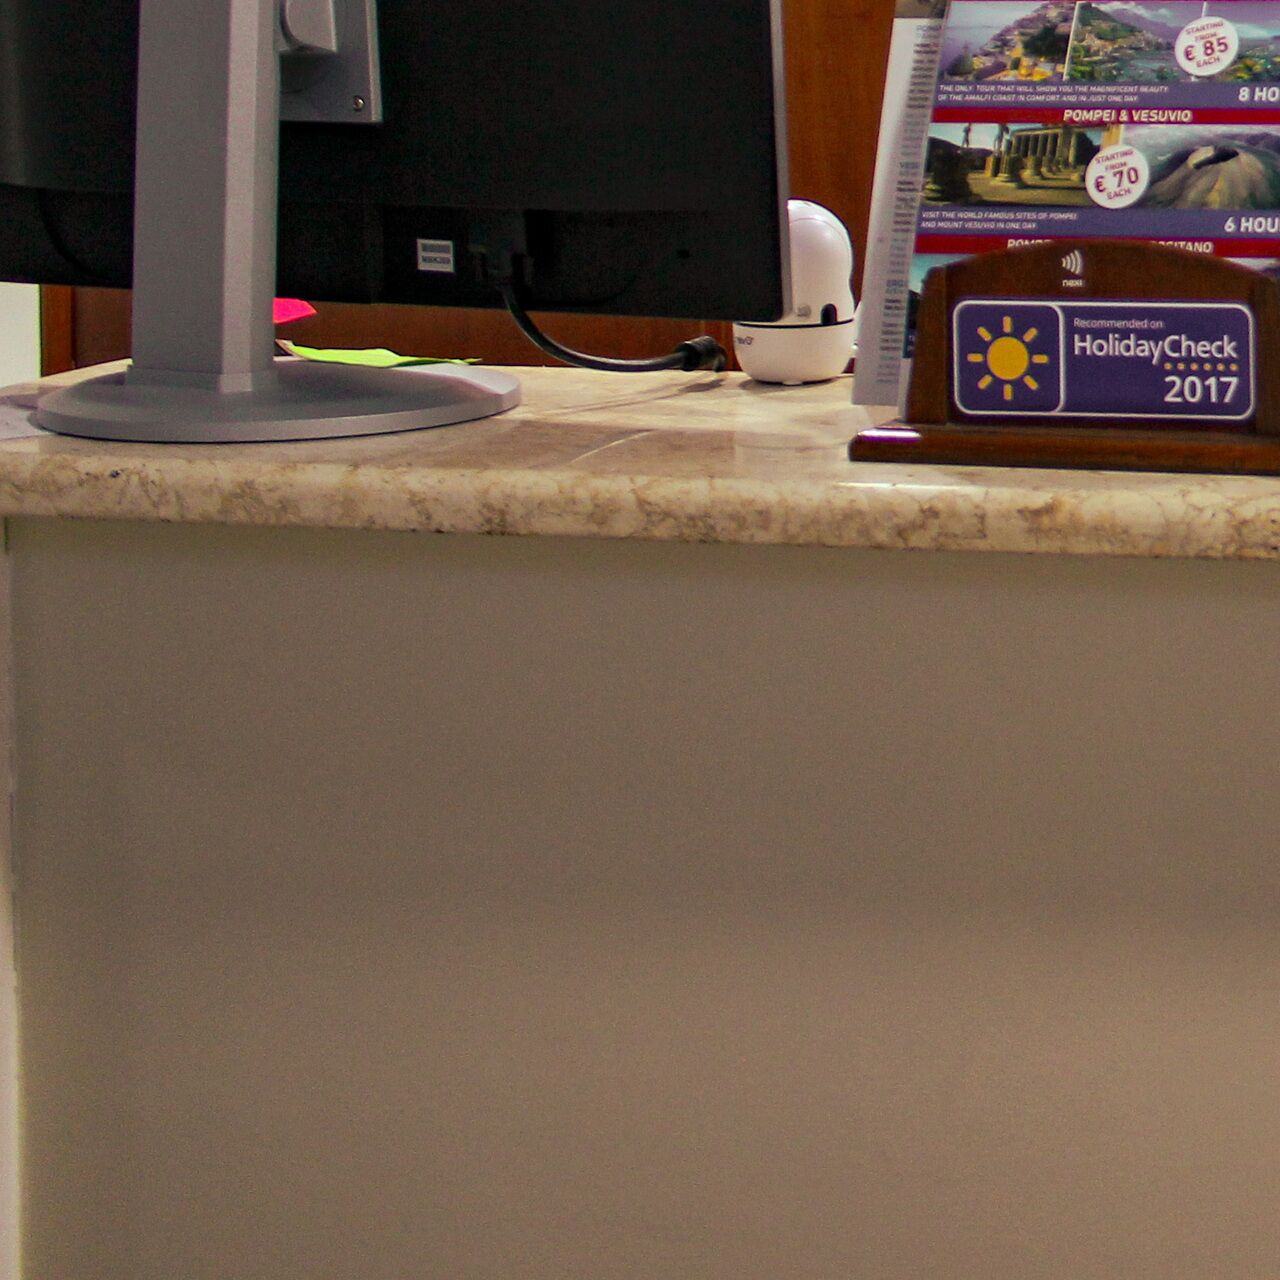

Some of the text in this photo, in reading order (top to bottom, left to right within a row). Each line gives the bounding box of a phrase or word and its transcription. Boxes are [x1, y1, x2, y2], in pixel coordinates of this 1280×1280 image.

[1184, 20, 1224, 36] STARTING
[1183, 41, 1229, 61] € 85
[1196, 56, 1221, 69] EACH
[940, 84, 1168, 93] THE ONLY TOUR THAT WILL SHOW YOU THE MAGNIFICENT BEAUTY
[1239, 87, 1250, 102] 8
[938, 94, 1139, 102] OF THE AMALFI COAST IN COMFORT AND IN JUST ONE DAY
[1063, 109, 1192, 122] POMPEI & VESUVIO
[1094, 149, 1134, 165] STARTING
[1104, 161, 1128, 172] FROM
[1094, 167, 1139, 193] € 70
[1106, 187, 1132, 200] EACH
[1224, 218, 1235, 232] 6
[1062, 279, 1083, 287] nexi
[1074, 318, 1163, 328] Recommended on
[1074, 334, 1237, 365] HolidayCheck
[1164, 376, 1239, 403] 2017
